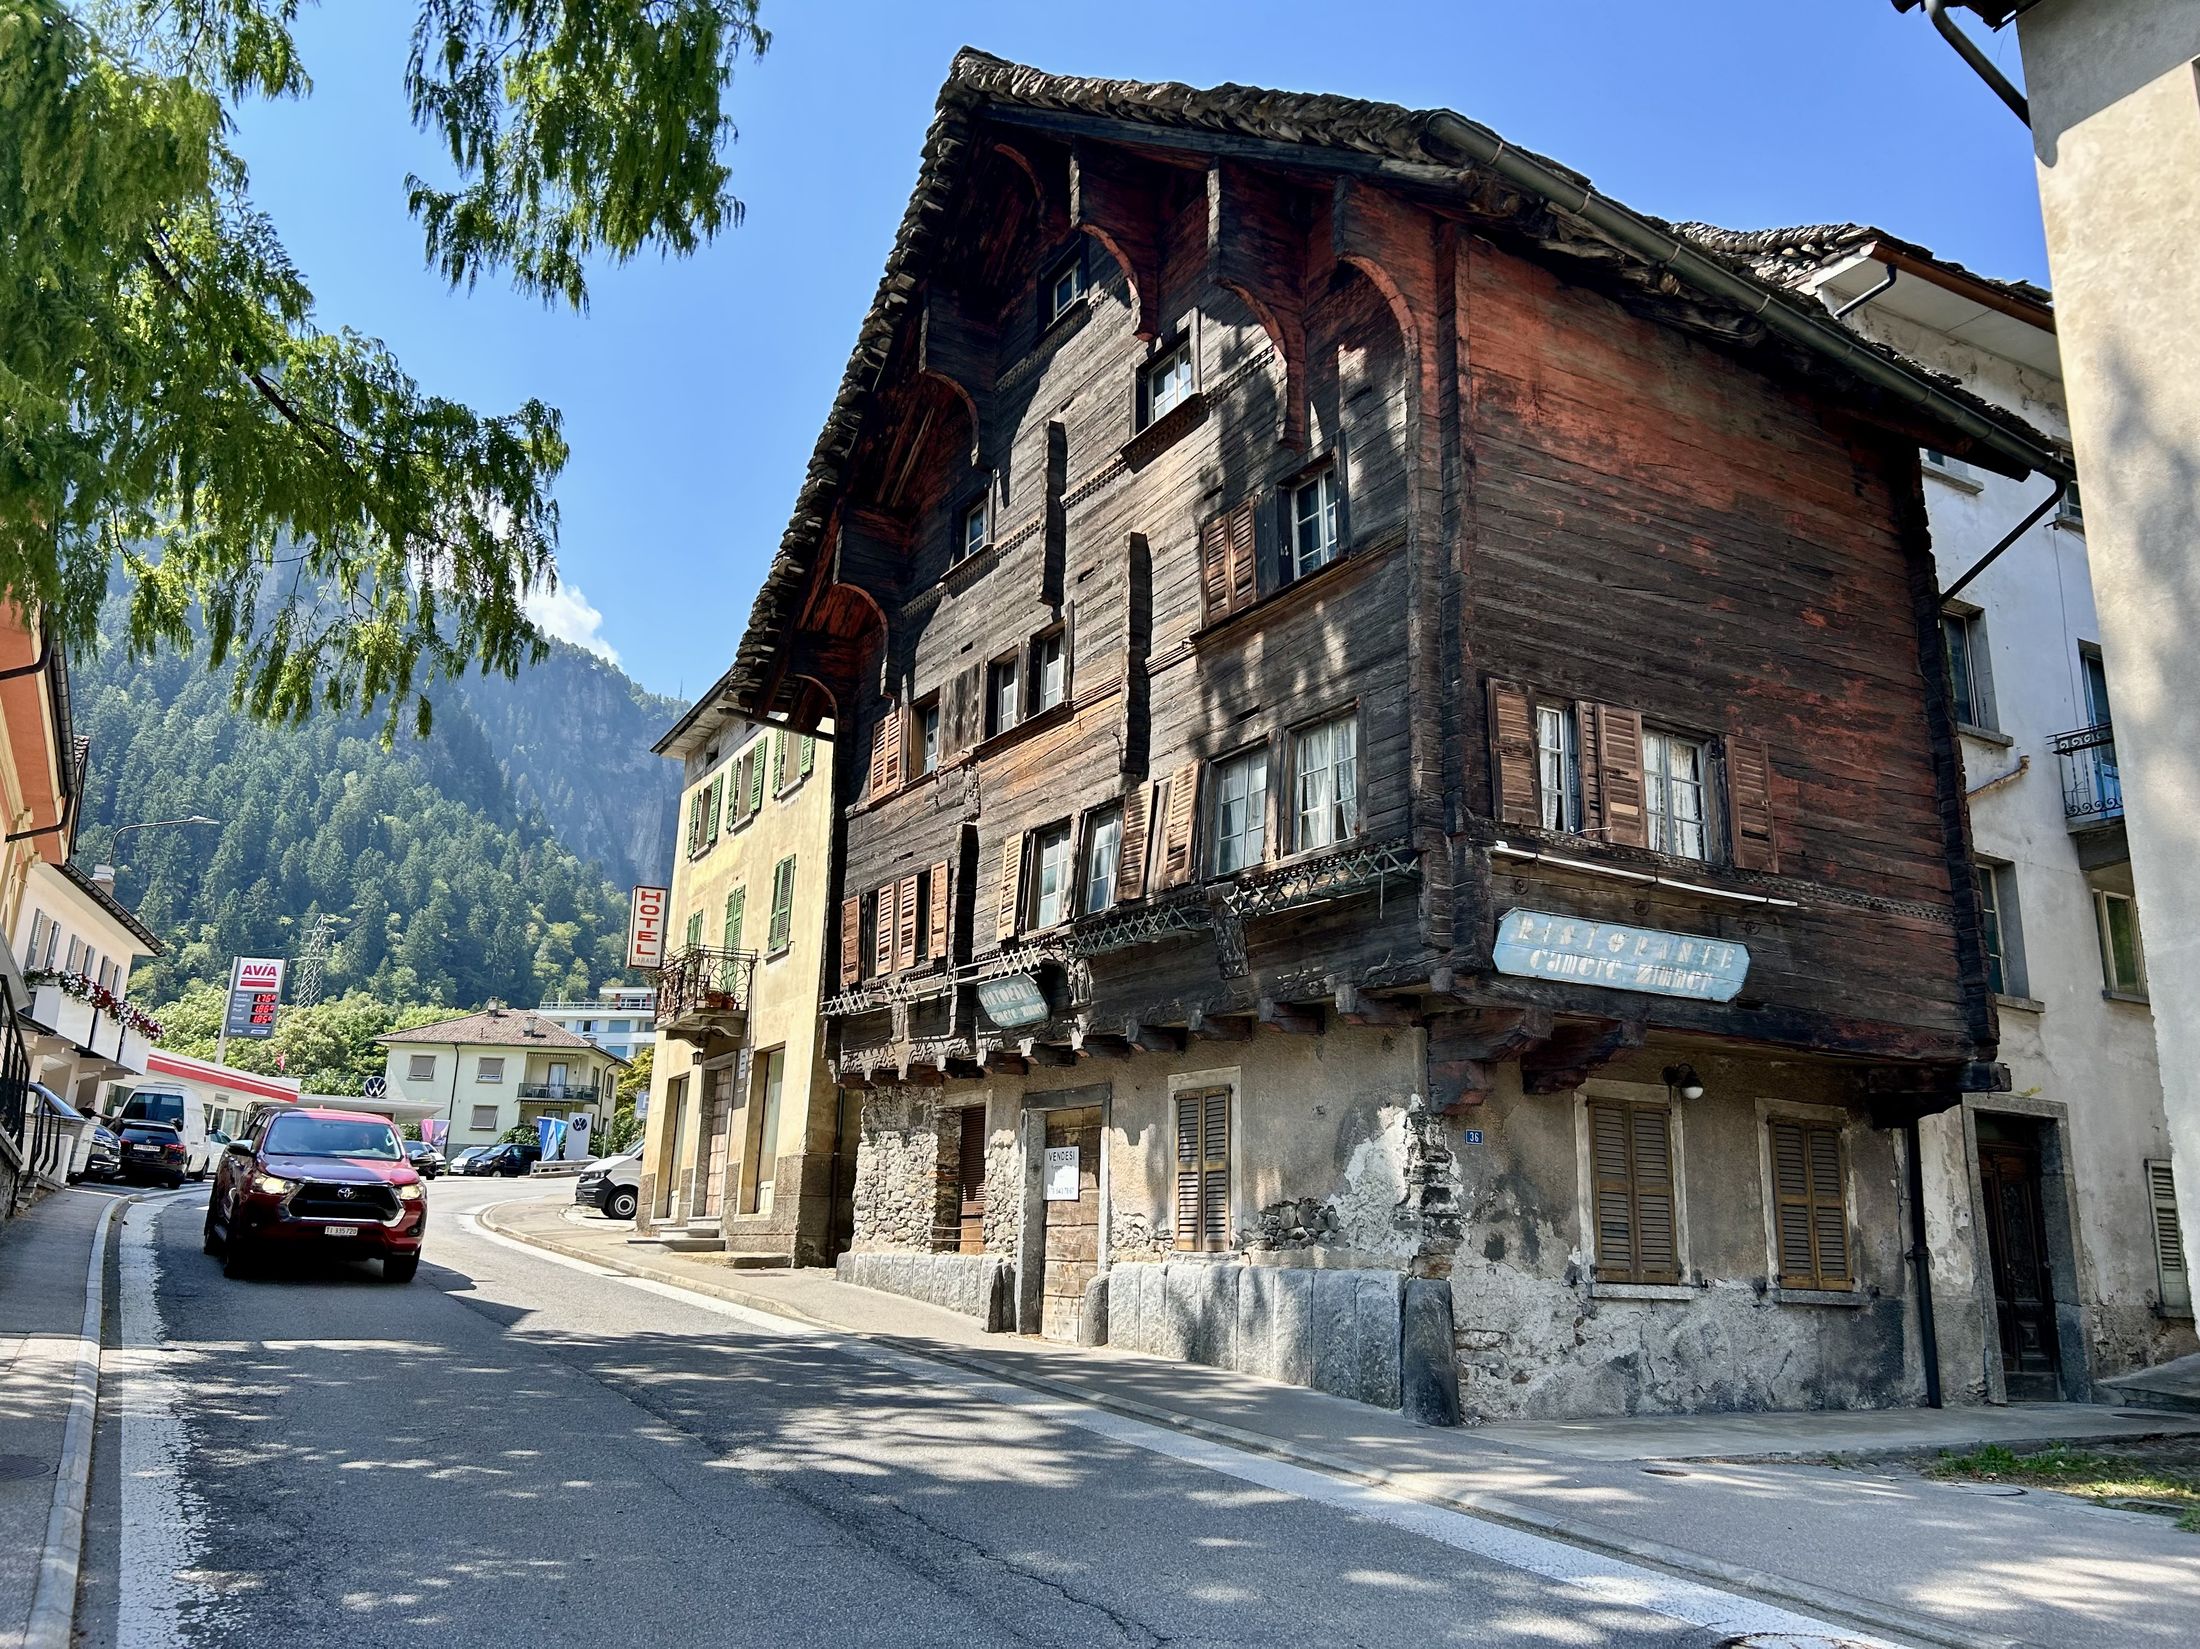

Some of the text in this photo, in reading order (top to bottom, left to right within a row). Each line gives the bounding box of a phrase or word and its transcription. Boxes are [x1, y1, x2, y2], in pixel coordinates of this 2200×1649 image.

[636, 890, 661, 955] HOTEL
[1518, 916, 1736, 969] RISTORANTE
[242, 963, 277, 977] AVIA
[1469, 1132, 1479, 1142] 36
[1048, 1150, 1076, 1161] VENDESI
